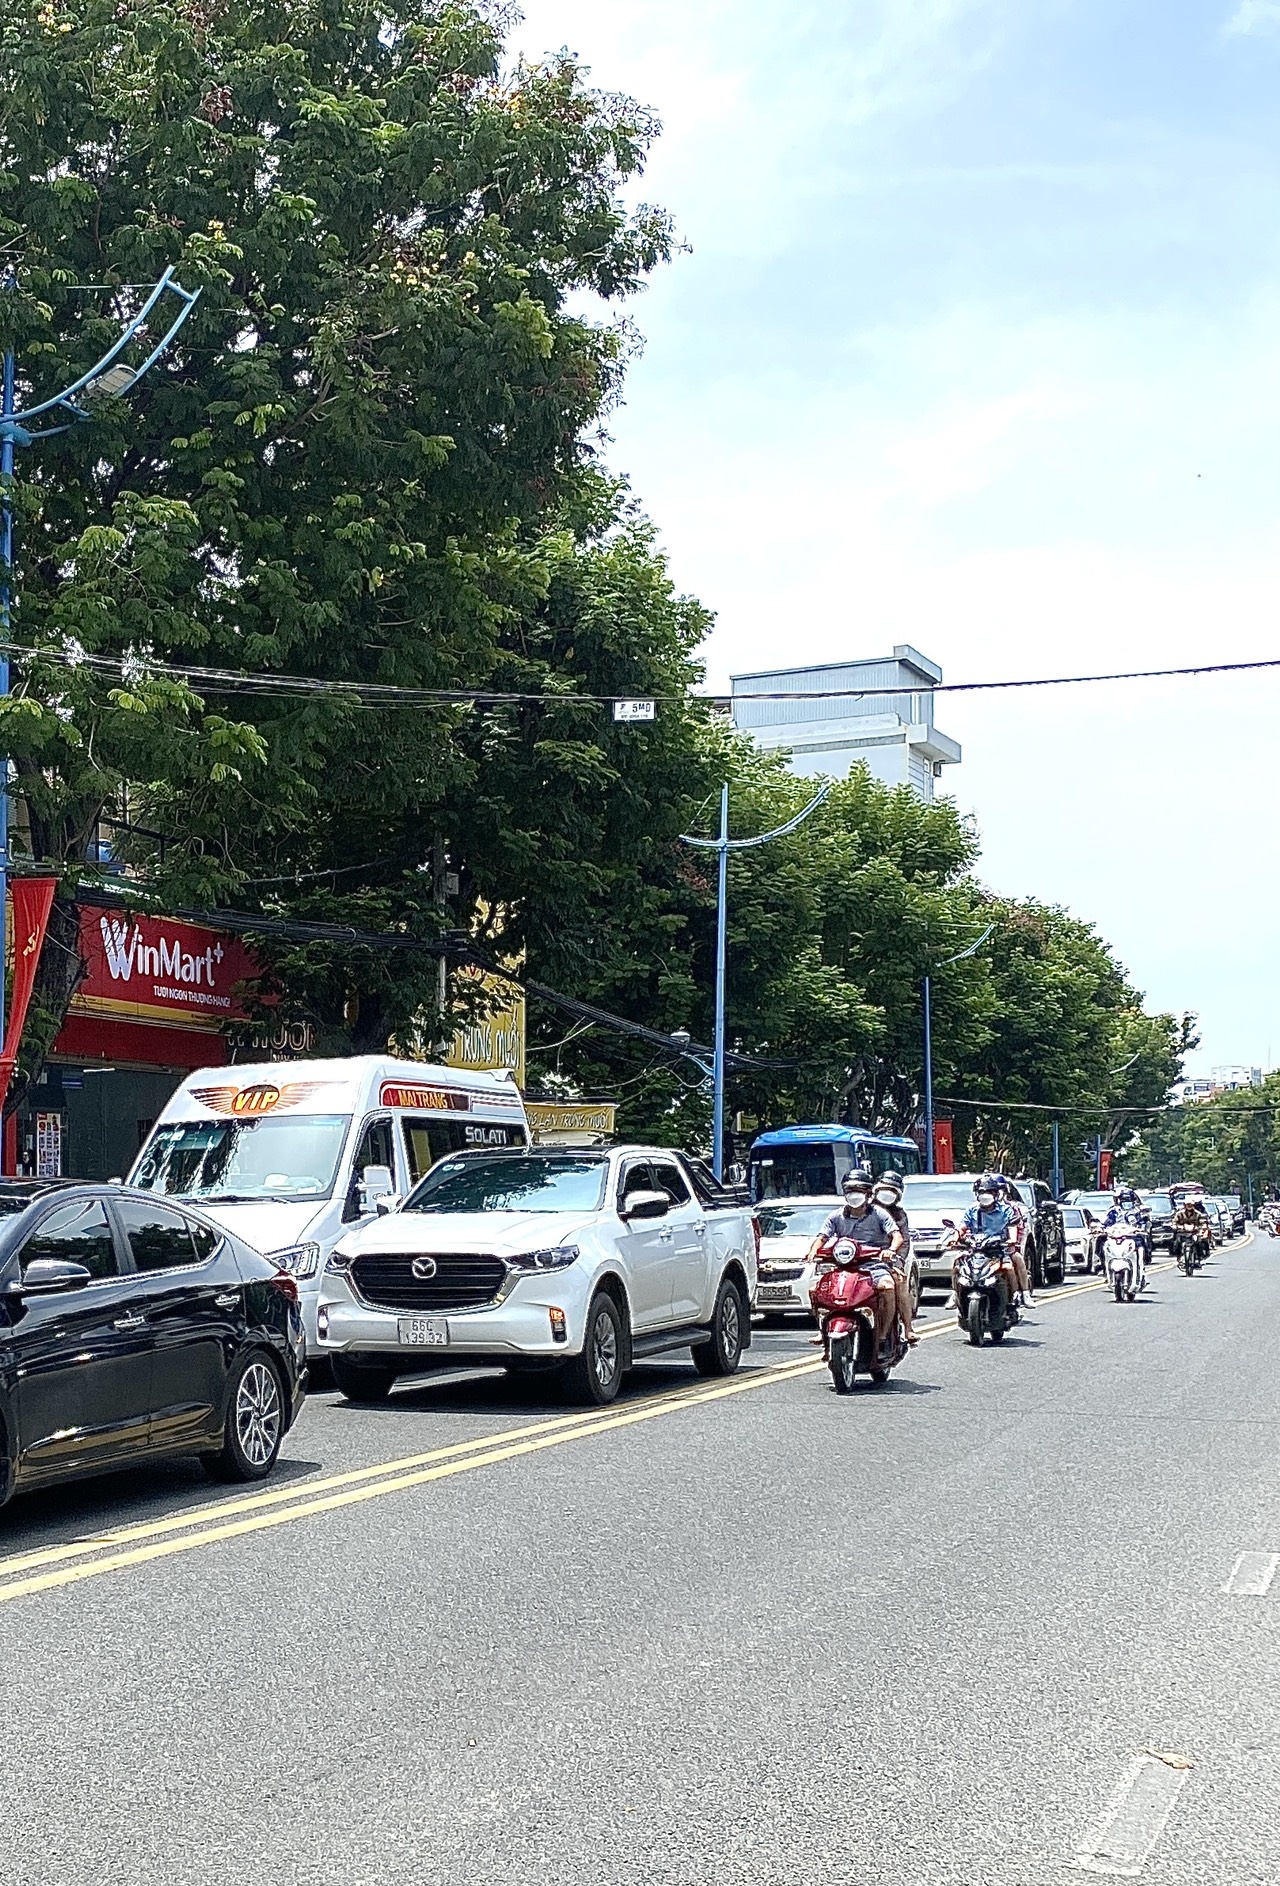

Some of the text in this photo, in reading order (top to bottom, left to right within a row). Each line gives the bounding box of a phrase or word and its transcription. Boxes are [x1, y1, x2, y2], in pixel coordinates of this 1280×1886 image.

[234, 1091, 279, 1111] VIP
[398, 1090, 448, 1109] MAI TRANG
[465, 1126, 507, 1145] SOLATI
[405, 1332, 443, 1344] 139.32
